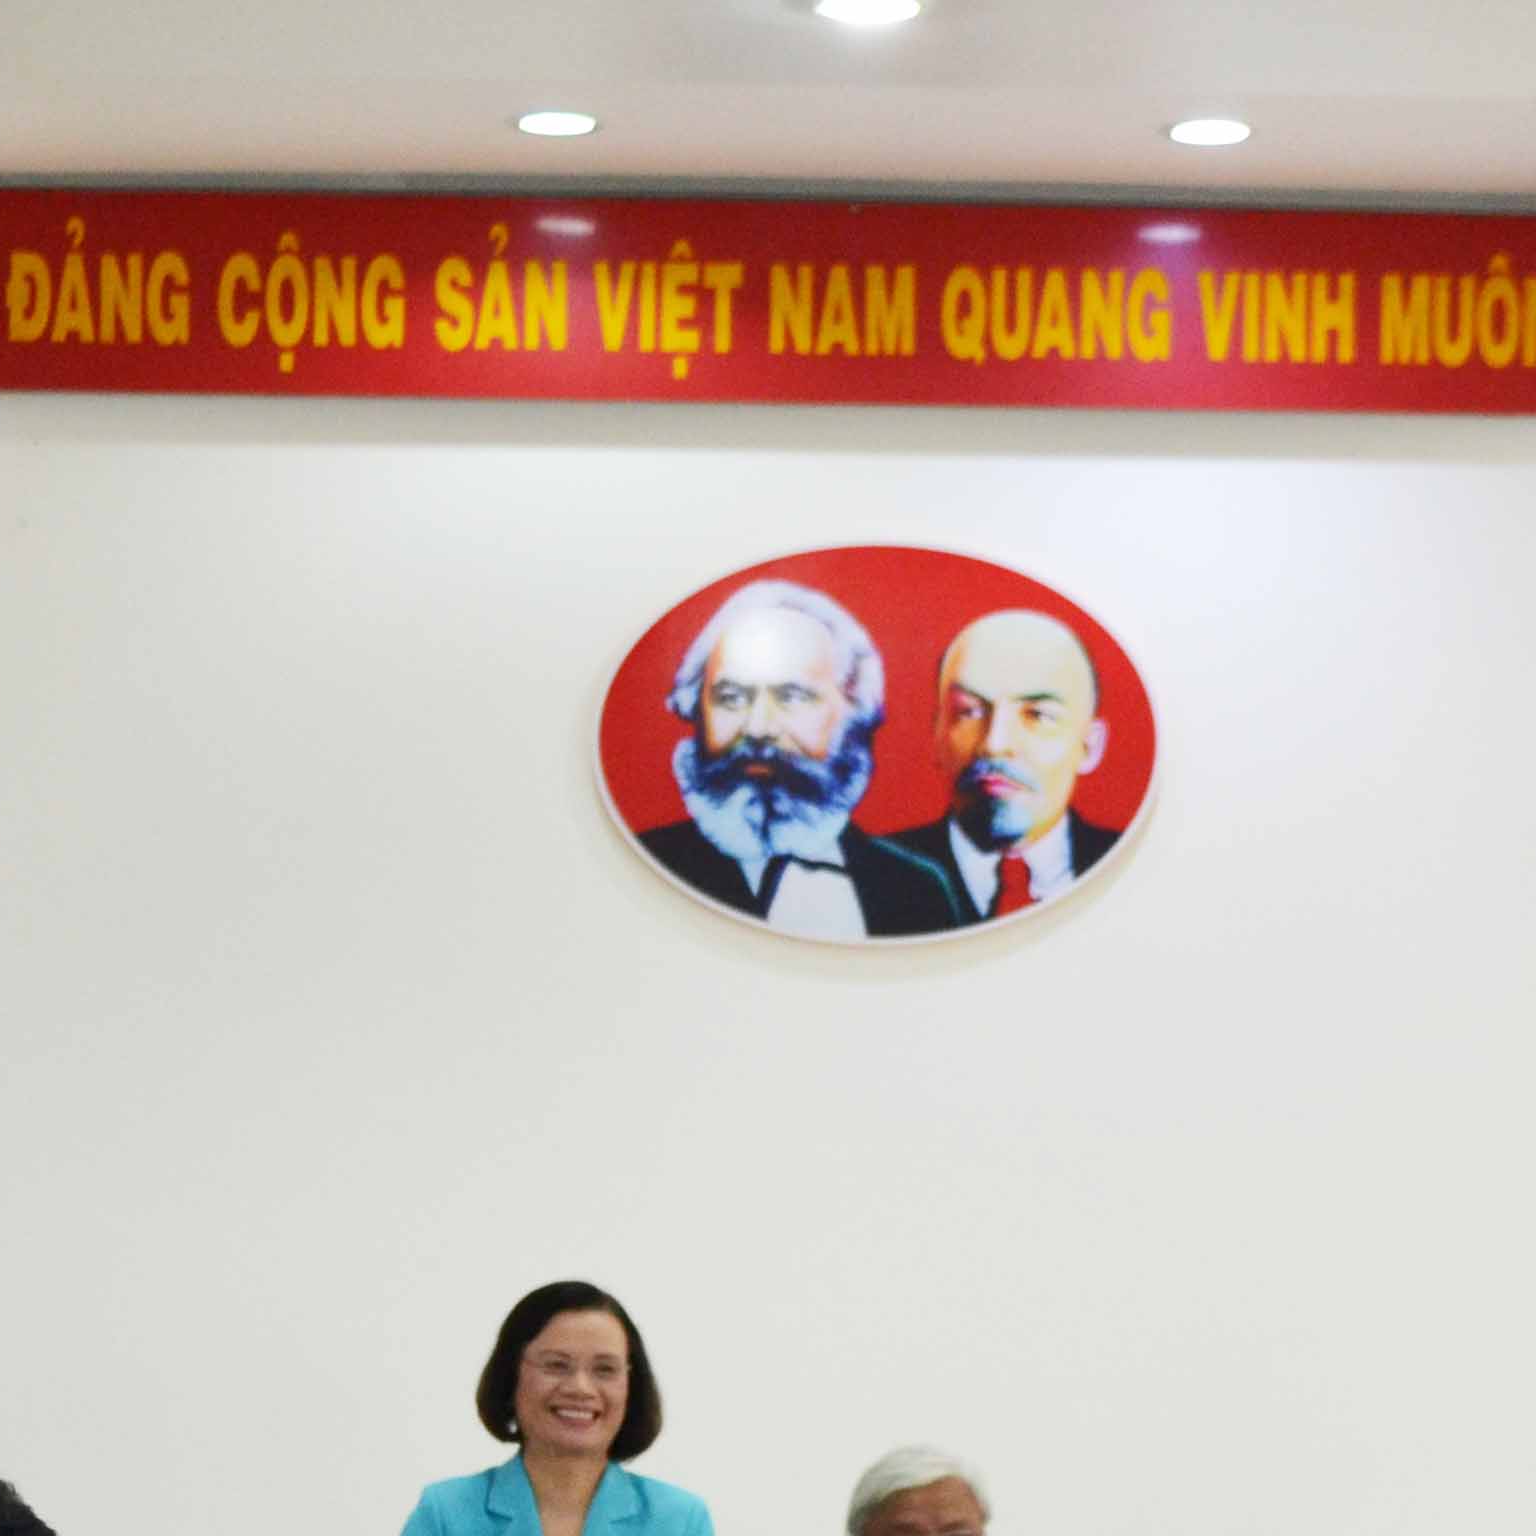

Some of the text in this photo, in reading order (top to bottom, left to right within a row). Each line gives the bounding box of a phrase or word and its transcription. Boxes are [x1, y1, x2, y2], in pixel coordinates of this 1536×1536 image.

[5, 218, 191, 347] ĐẢNG
[217, 232, 406, 372] CỘNG
[435, 224, 569, 353] SẢN
[592, 238, 744, 380] VIỆT
[768, 265, 916, 356] NAM
[940, 266, 1171, 366] QUANG
[1196, 269, 1358, 364] VINH
